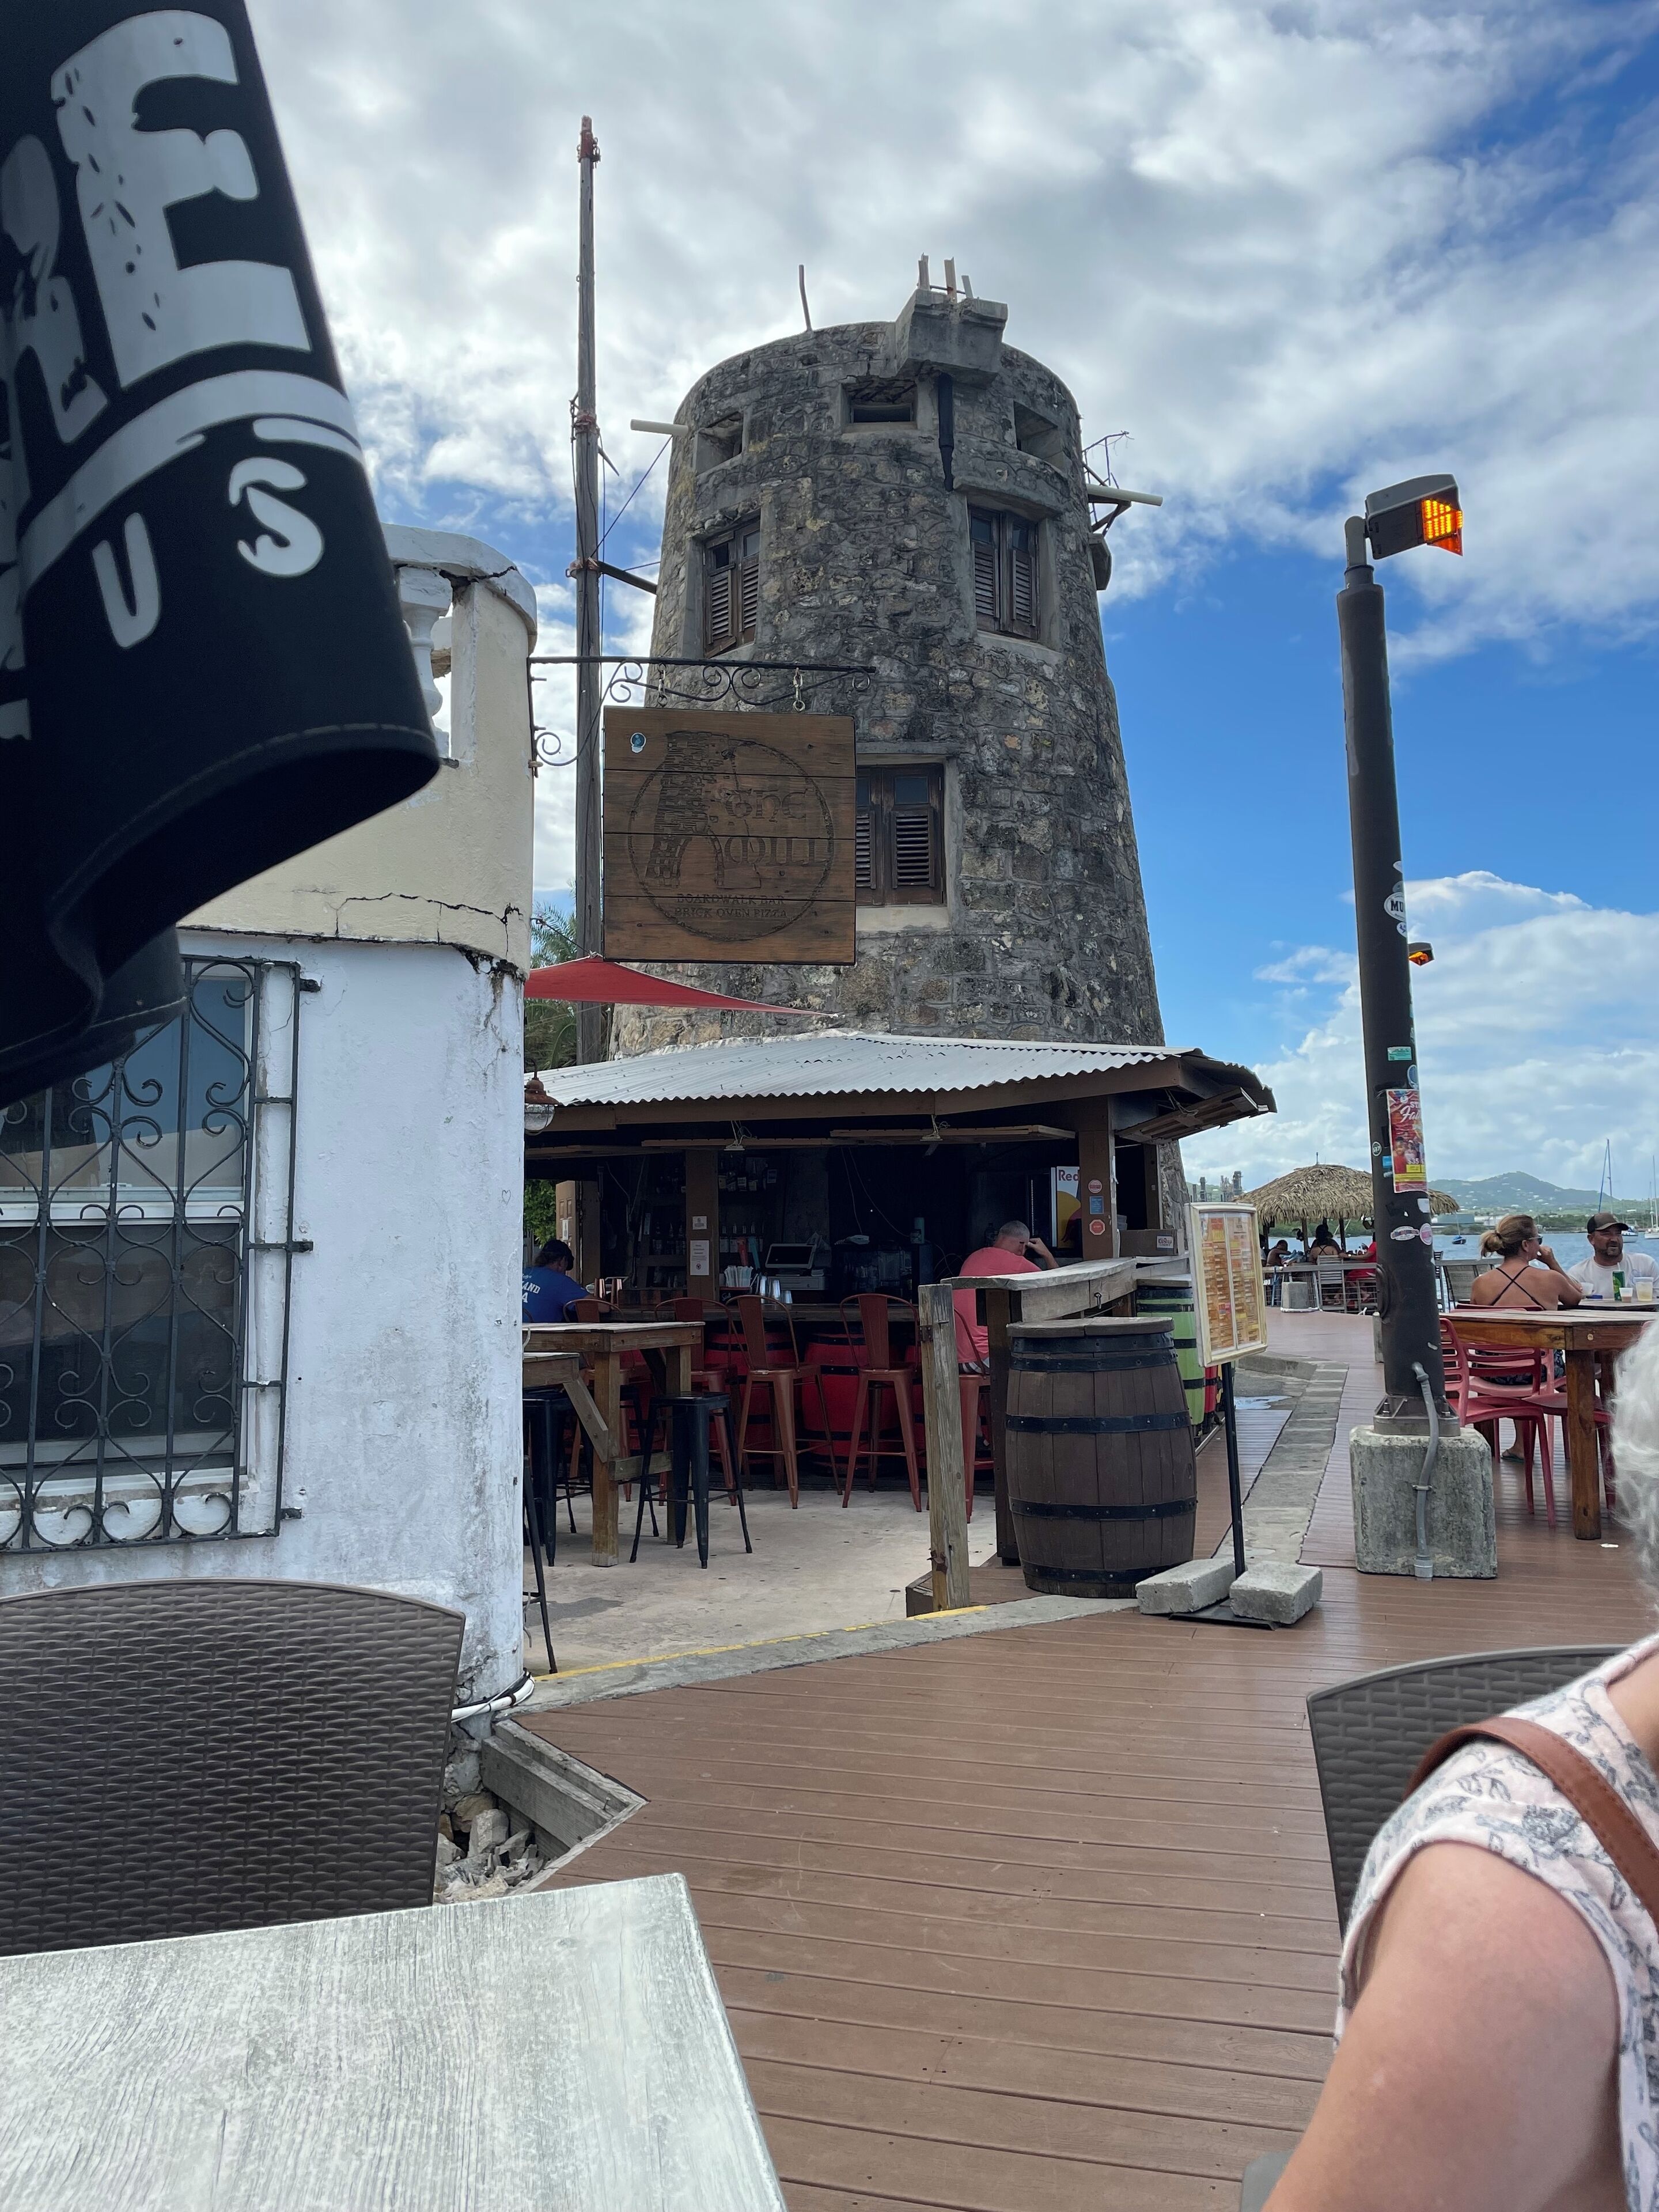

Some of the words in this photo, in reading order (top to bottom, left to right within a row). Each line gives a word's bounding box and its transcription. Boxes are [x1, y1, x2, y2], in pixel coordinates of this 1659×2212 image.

[677, 893, 756, 905] BOARDWALK
[760, 895, 785, 906] BAR
[674, 907, 713, 918] BRICK
[716, 908, 750, 918] OVEN
[753, 909, 787, 918] PIZZA
